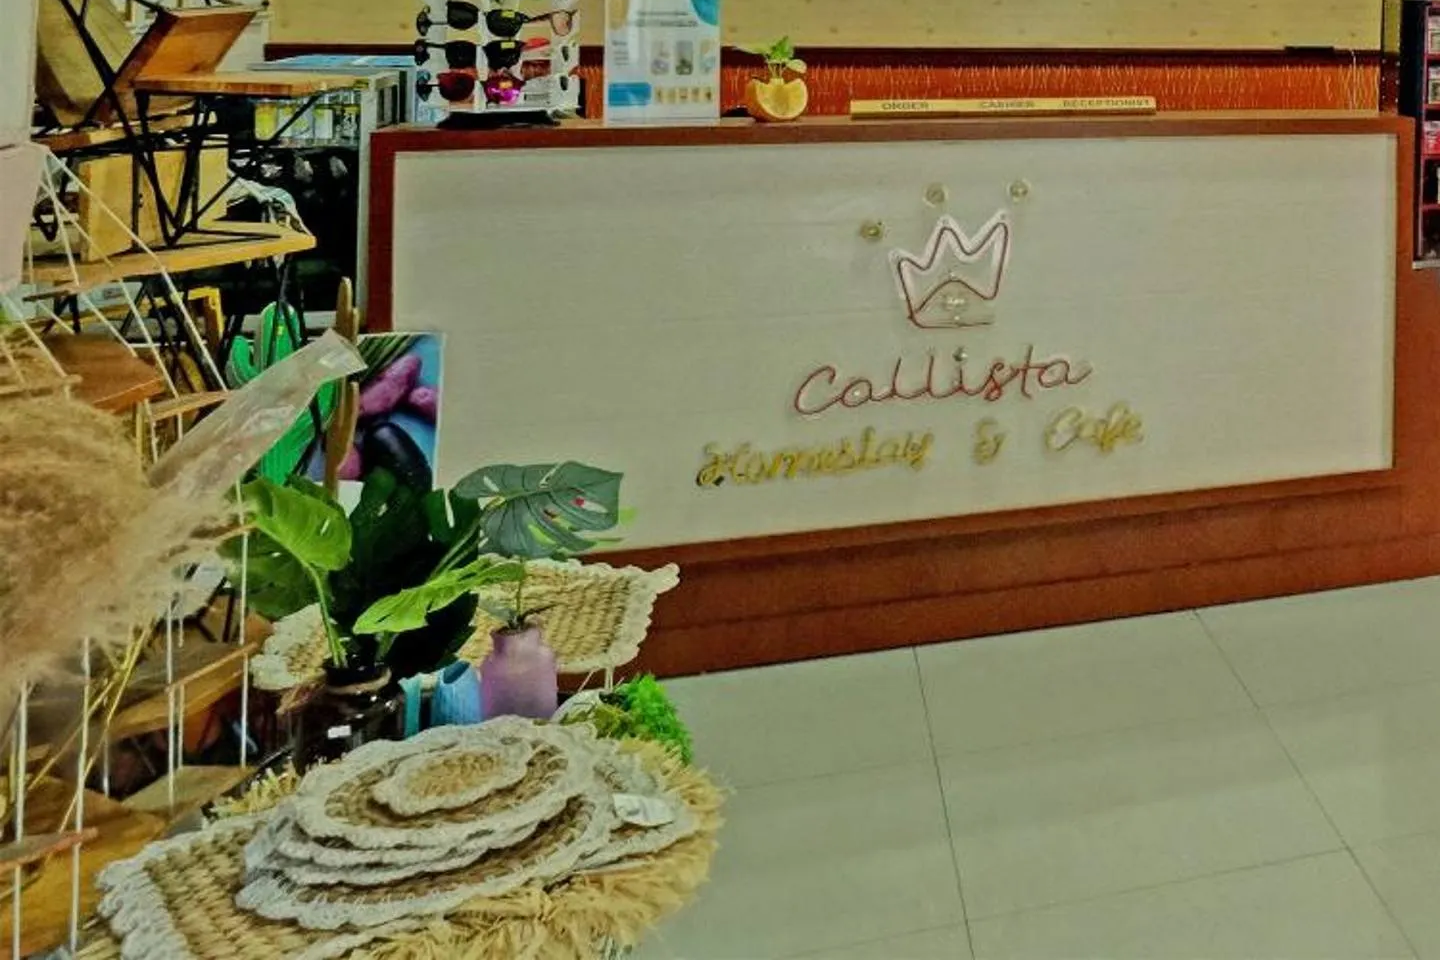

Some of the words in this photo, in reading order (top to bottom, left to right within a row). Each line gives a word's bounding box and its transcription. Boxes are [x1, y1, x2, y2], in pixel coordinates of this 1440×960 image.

[881, 102, 930, 110] ORDER
[980, 100, 1035, 109] CASHIER
[1063, 98, 1150, 108] RECEPTIONIST
[794, 344, 1094, 416] Callista
[695, 426, 934, 488] Homestay
